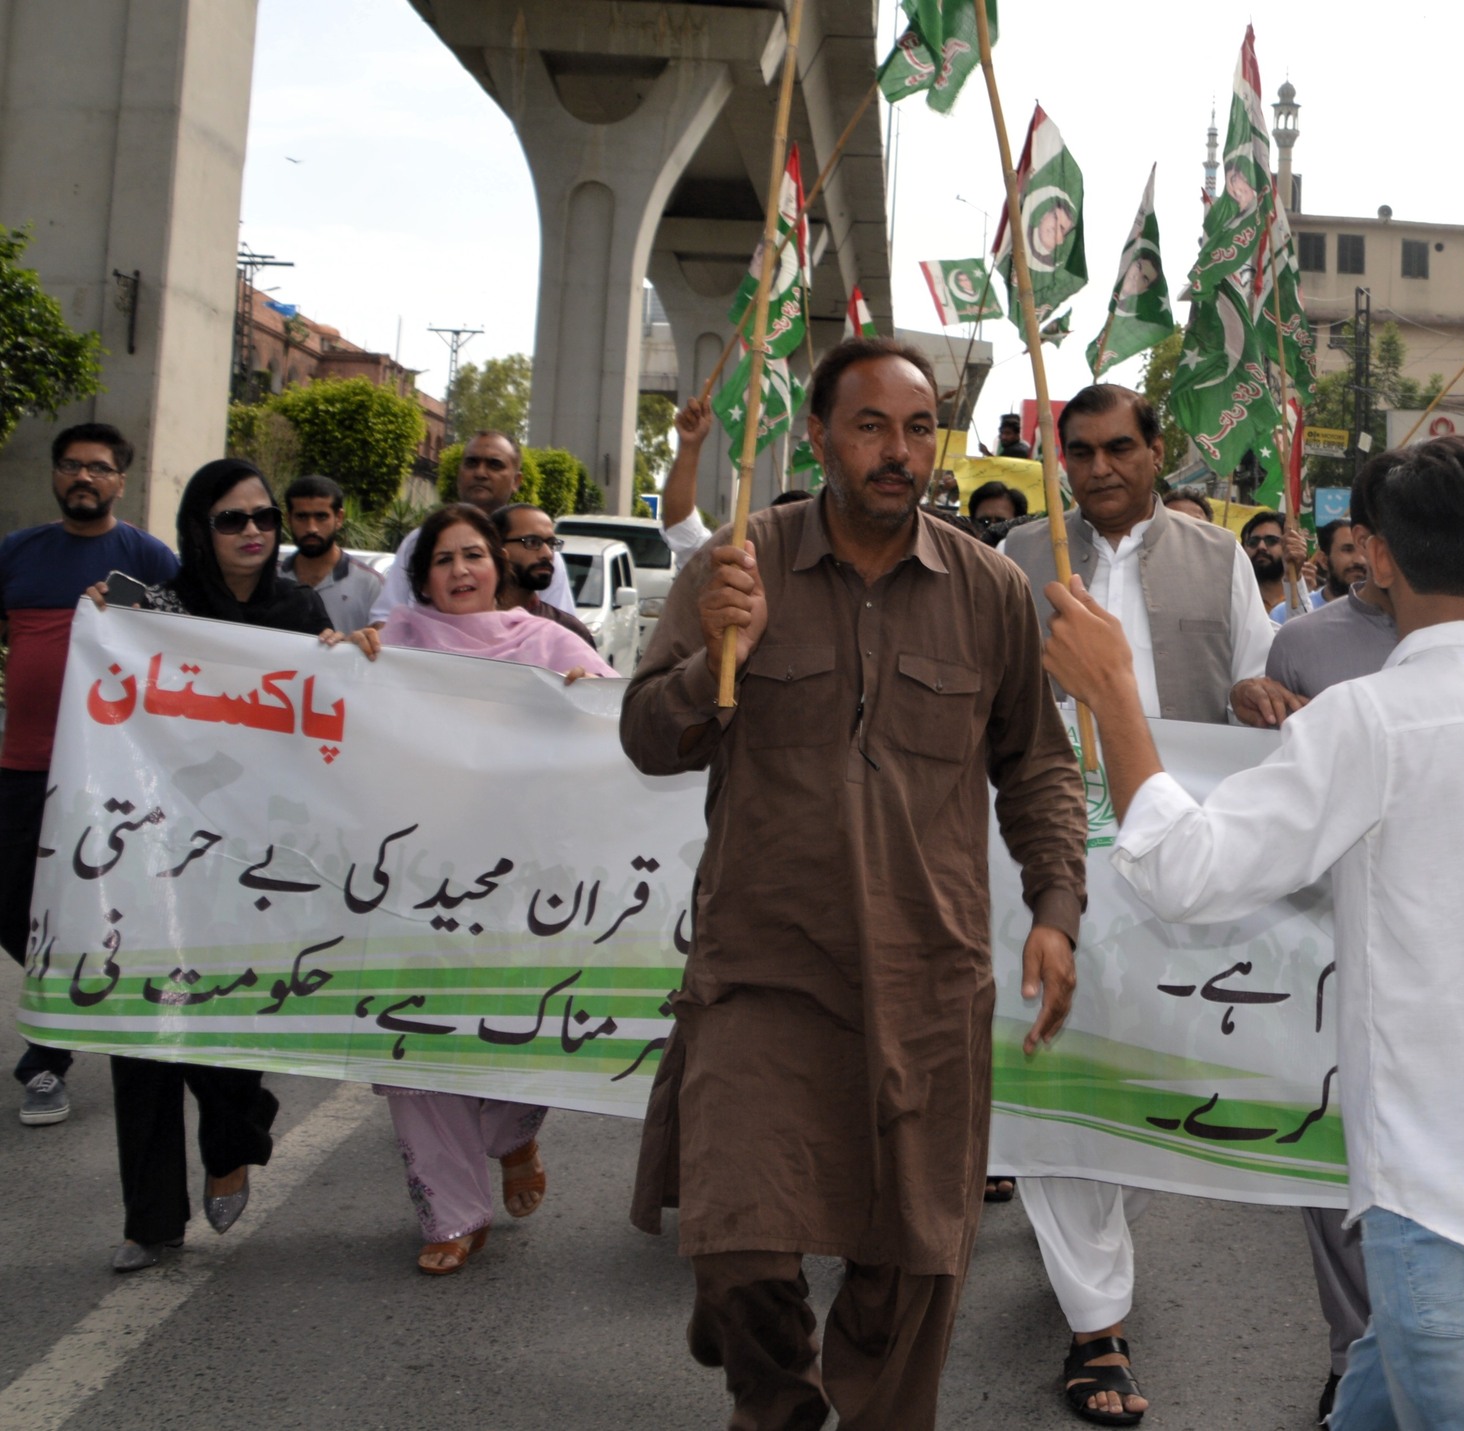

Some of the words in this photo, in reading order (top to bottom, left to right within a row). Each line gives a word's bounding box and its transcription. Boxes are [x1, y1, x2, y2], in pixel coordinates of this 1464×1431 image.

[86, 652, 346, 764] پاکستان
[239, 844, 321, 911] بے
[344, 823, 419, 913] کی
[414, 857, 514, 935] مجید
[68, 908, 122, 1006] فی
[143, 935, 345, 1015] حکومت
